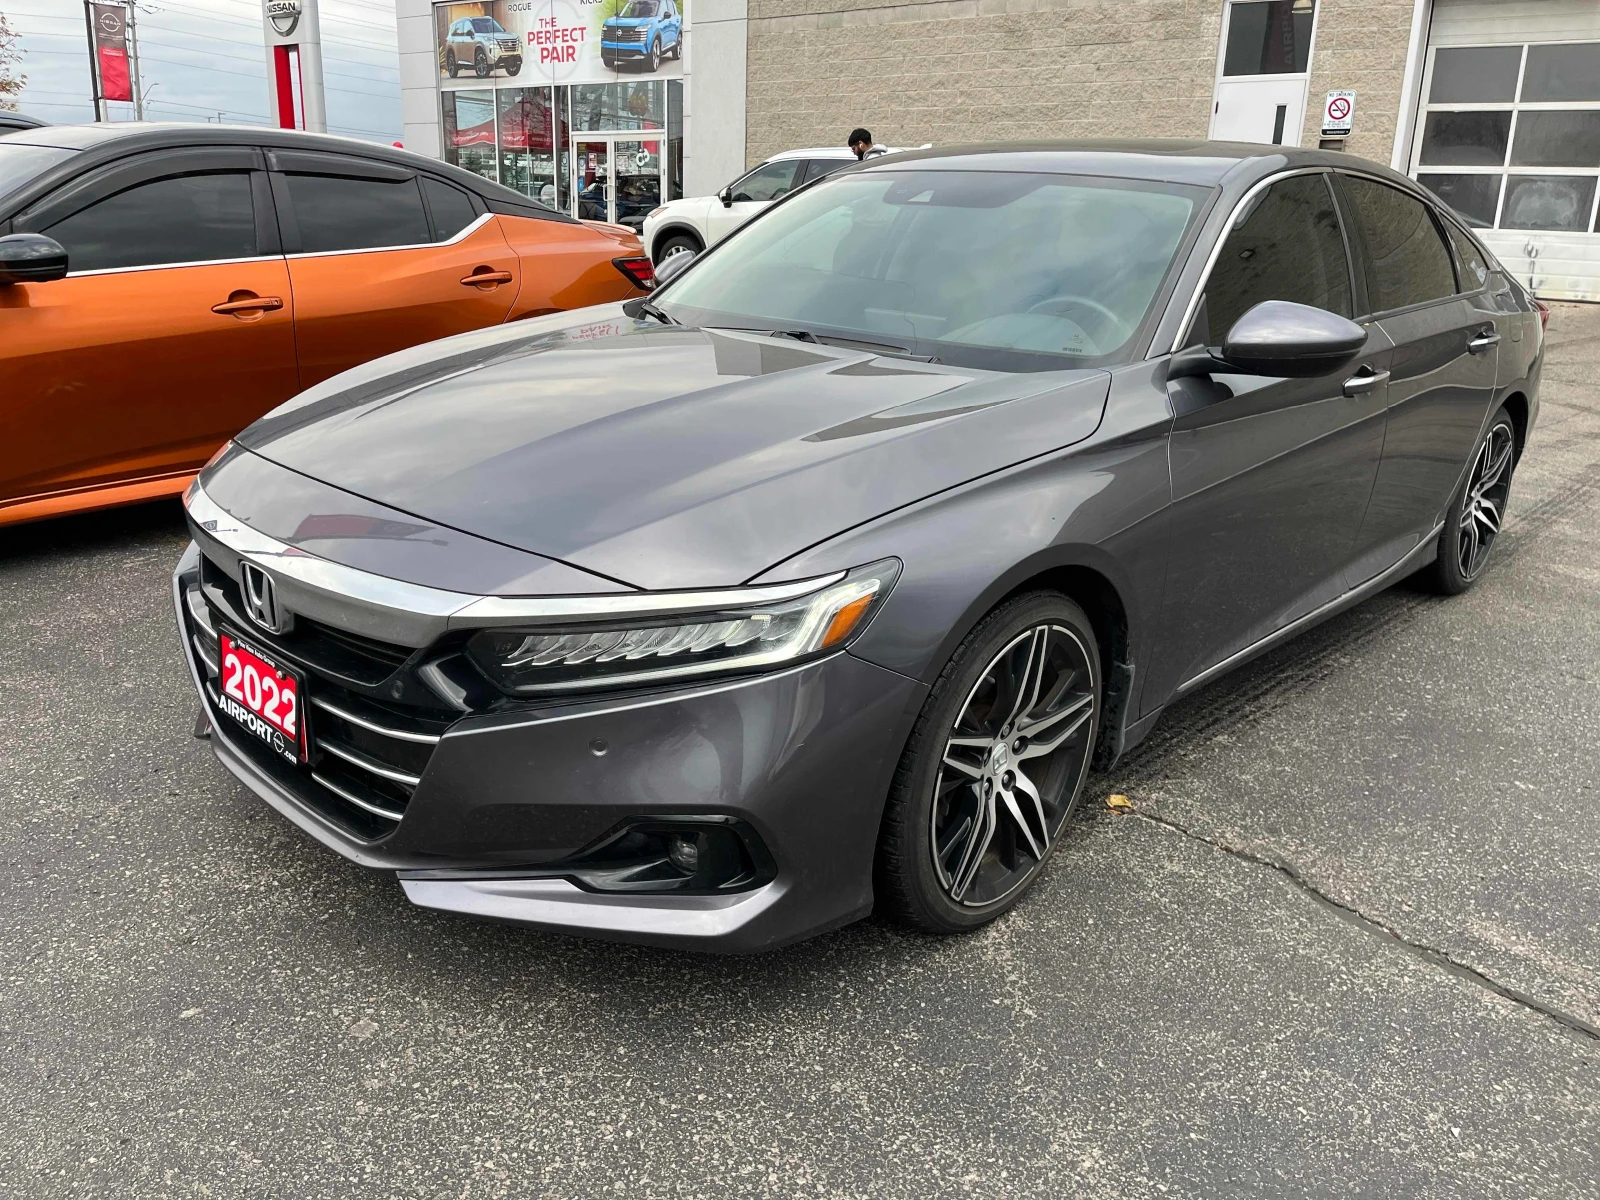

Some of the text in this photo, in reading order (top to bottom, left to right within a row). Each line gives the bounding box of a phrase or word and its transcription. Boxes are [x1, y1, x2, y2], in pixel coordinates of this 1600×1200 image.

[267, 2, 296, 14] NISSAN
[508, 2, 532, 12] ROGUE
[539, 17, 557, 28] THE
[527, 27, 587, 46] PERFECT
[540, 45, 576, 64] PAIR
[224, 653, 296, 736] 2022
[218, 694, 273, 744] AIRPORT
